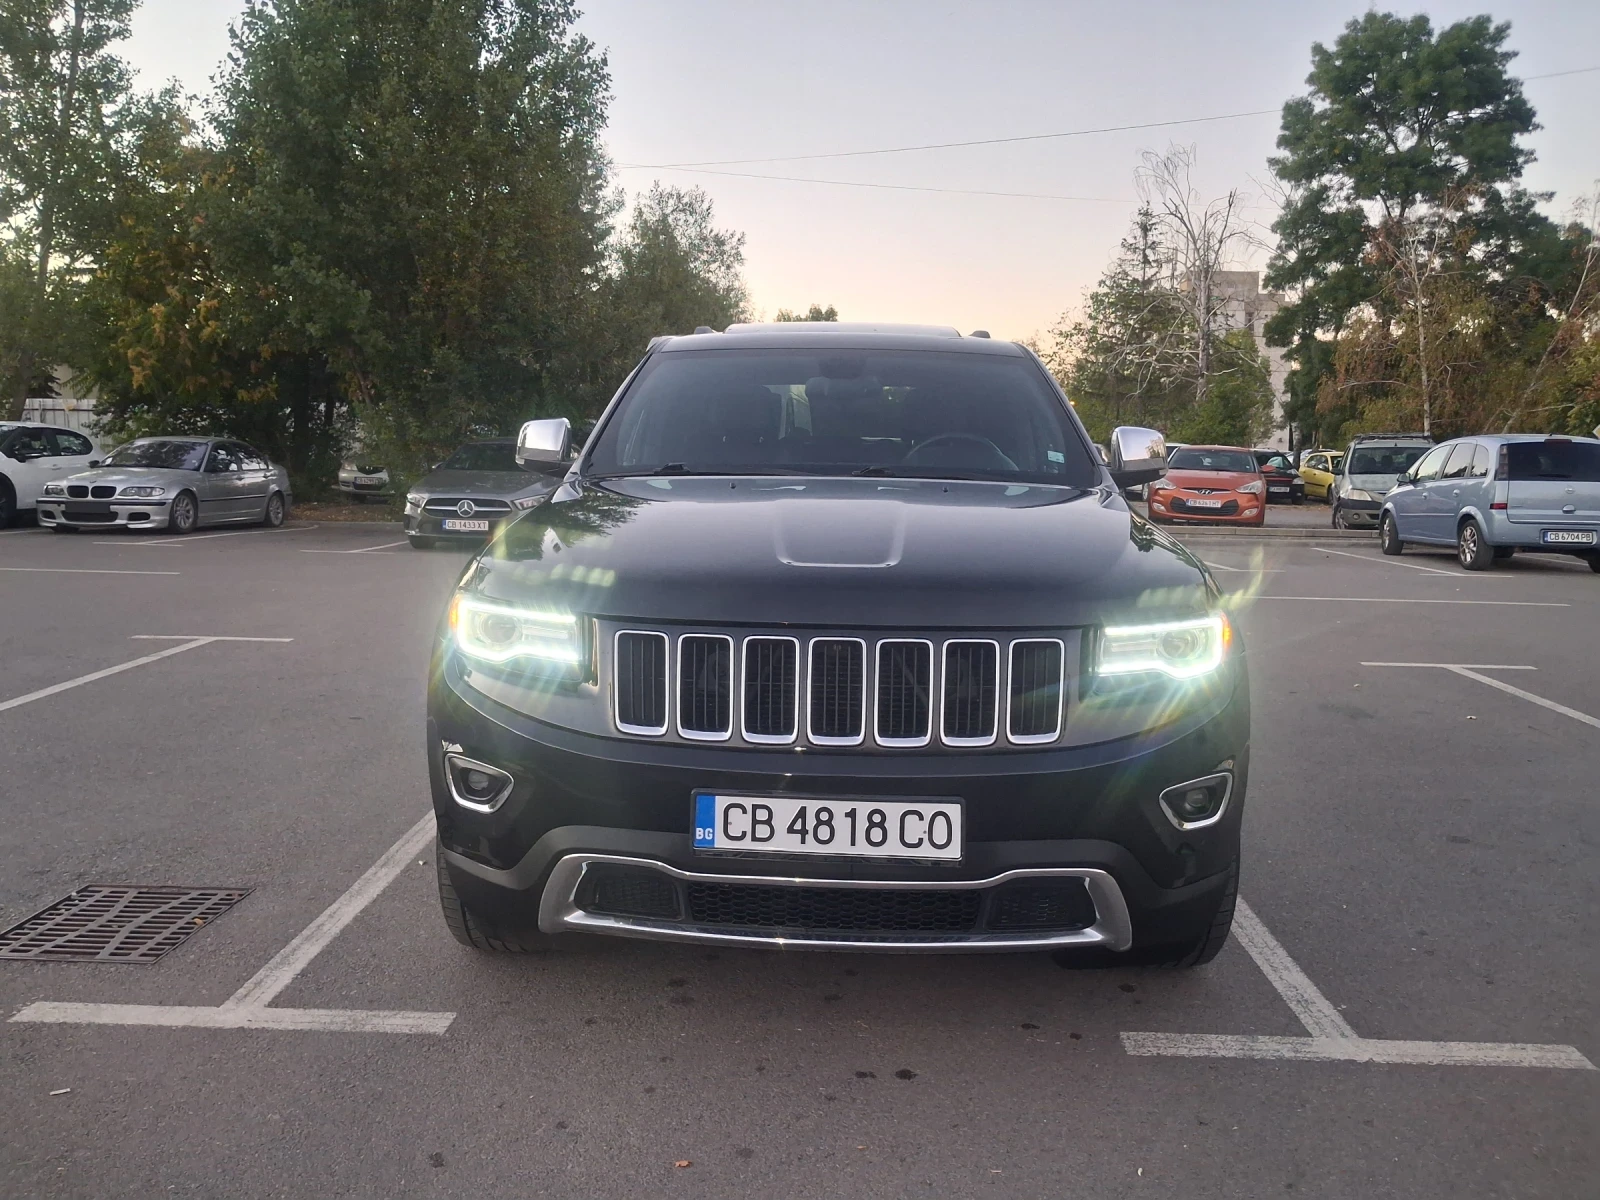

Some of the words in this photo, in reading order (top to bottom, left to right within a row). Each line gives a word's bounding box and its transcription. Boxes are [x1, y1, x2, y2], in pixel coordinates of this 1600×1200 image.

[447, 521, 456, 529] CB
[459, 521, 475, 529] 1433
[1550, 533, 1560, 541] CB
[1561, 533, 1580, 541] 6704
[1581, 533, 1591, 541] PB
[723, 802, 775, 843] CB
[786, 805, 888, 847] 4818
[899, 809, 953, 850] CO
[695, 827, 713, 840] BG
